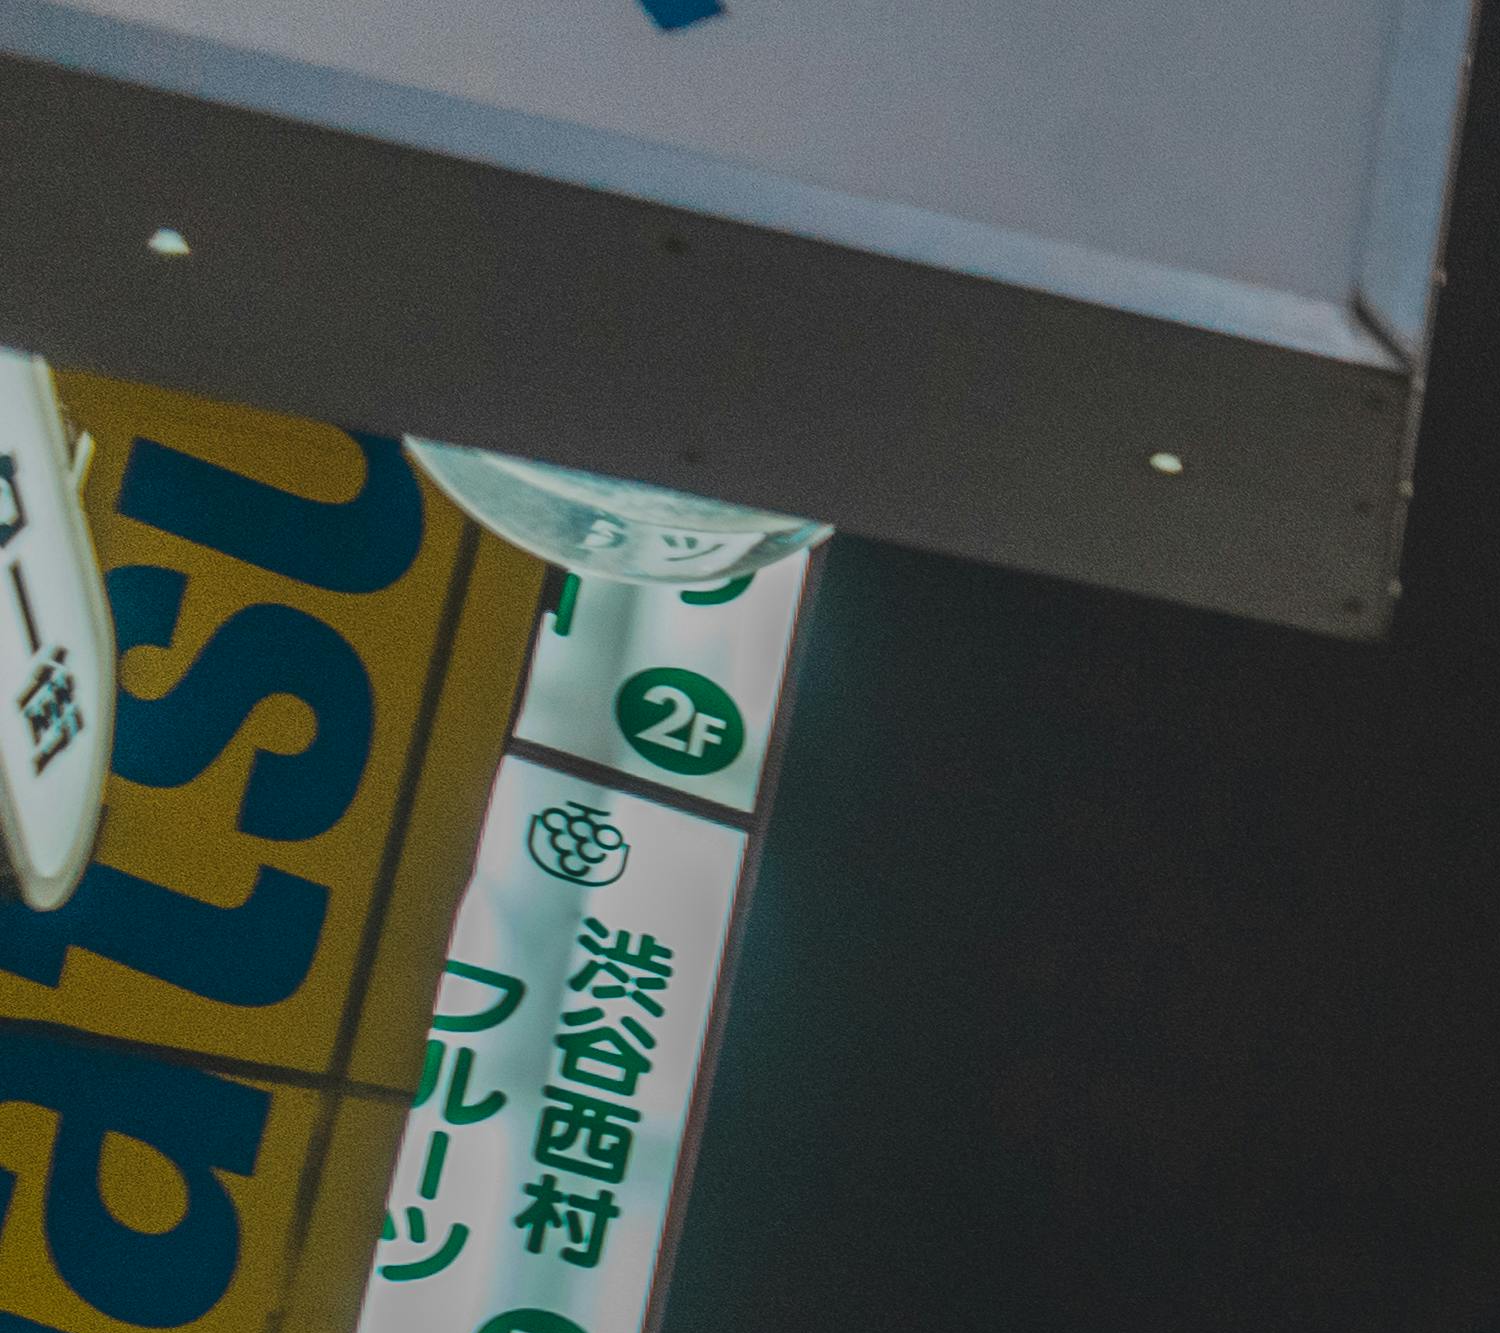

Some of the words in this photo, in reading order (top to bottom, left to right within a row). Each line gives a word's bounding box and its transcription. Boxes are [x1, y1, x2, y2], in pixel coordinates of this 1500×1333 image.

[637, 684, 729, 757] 2F
[375, 960, 527, 1282] フルーツ
[514, 916, 674, 1270] 渋谷西村
